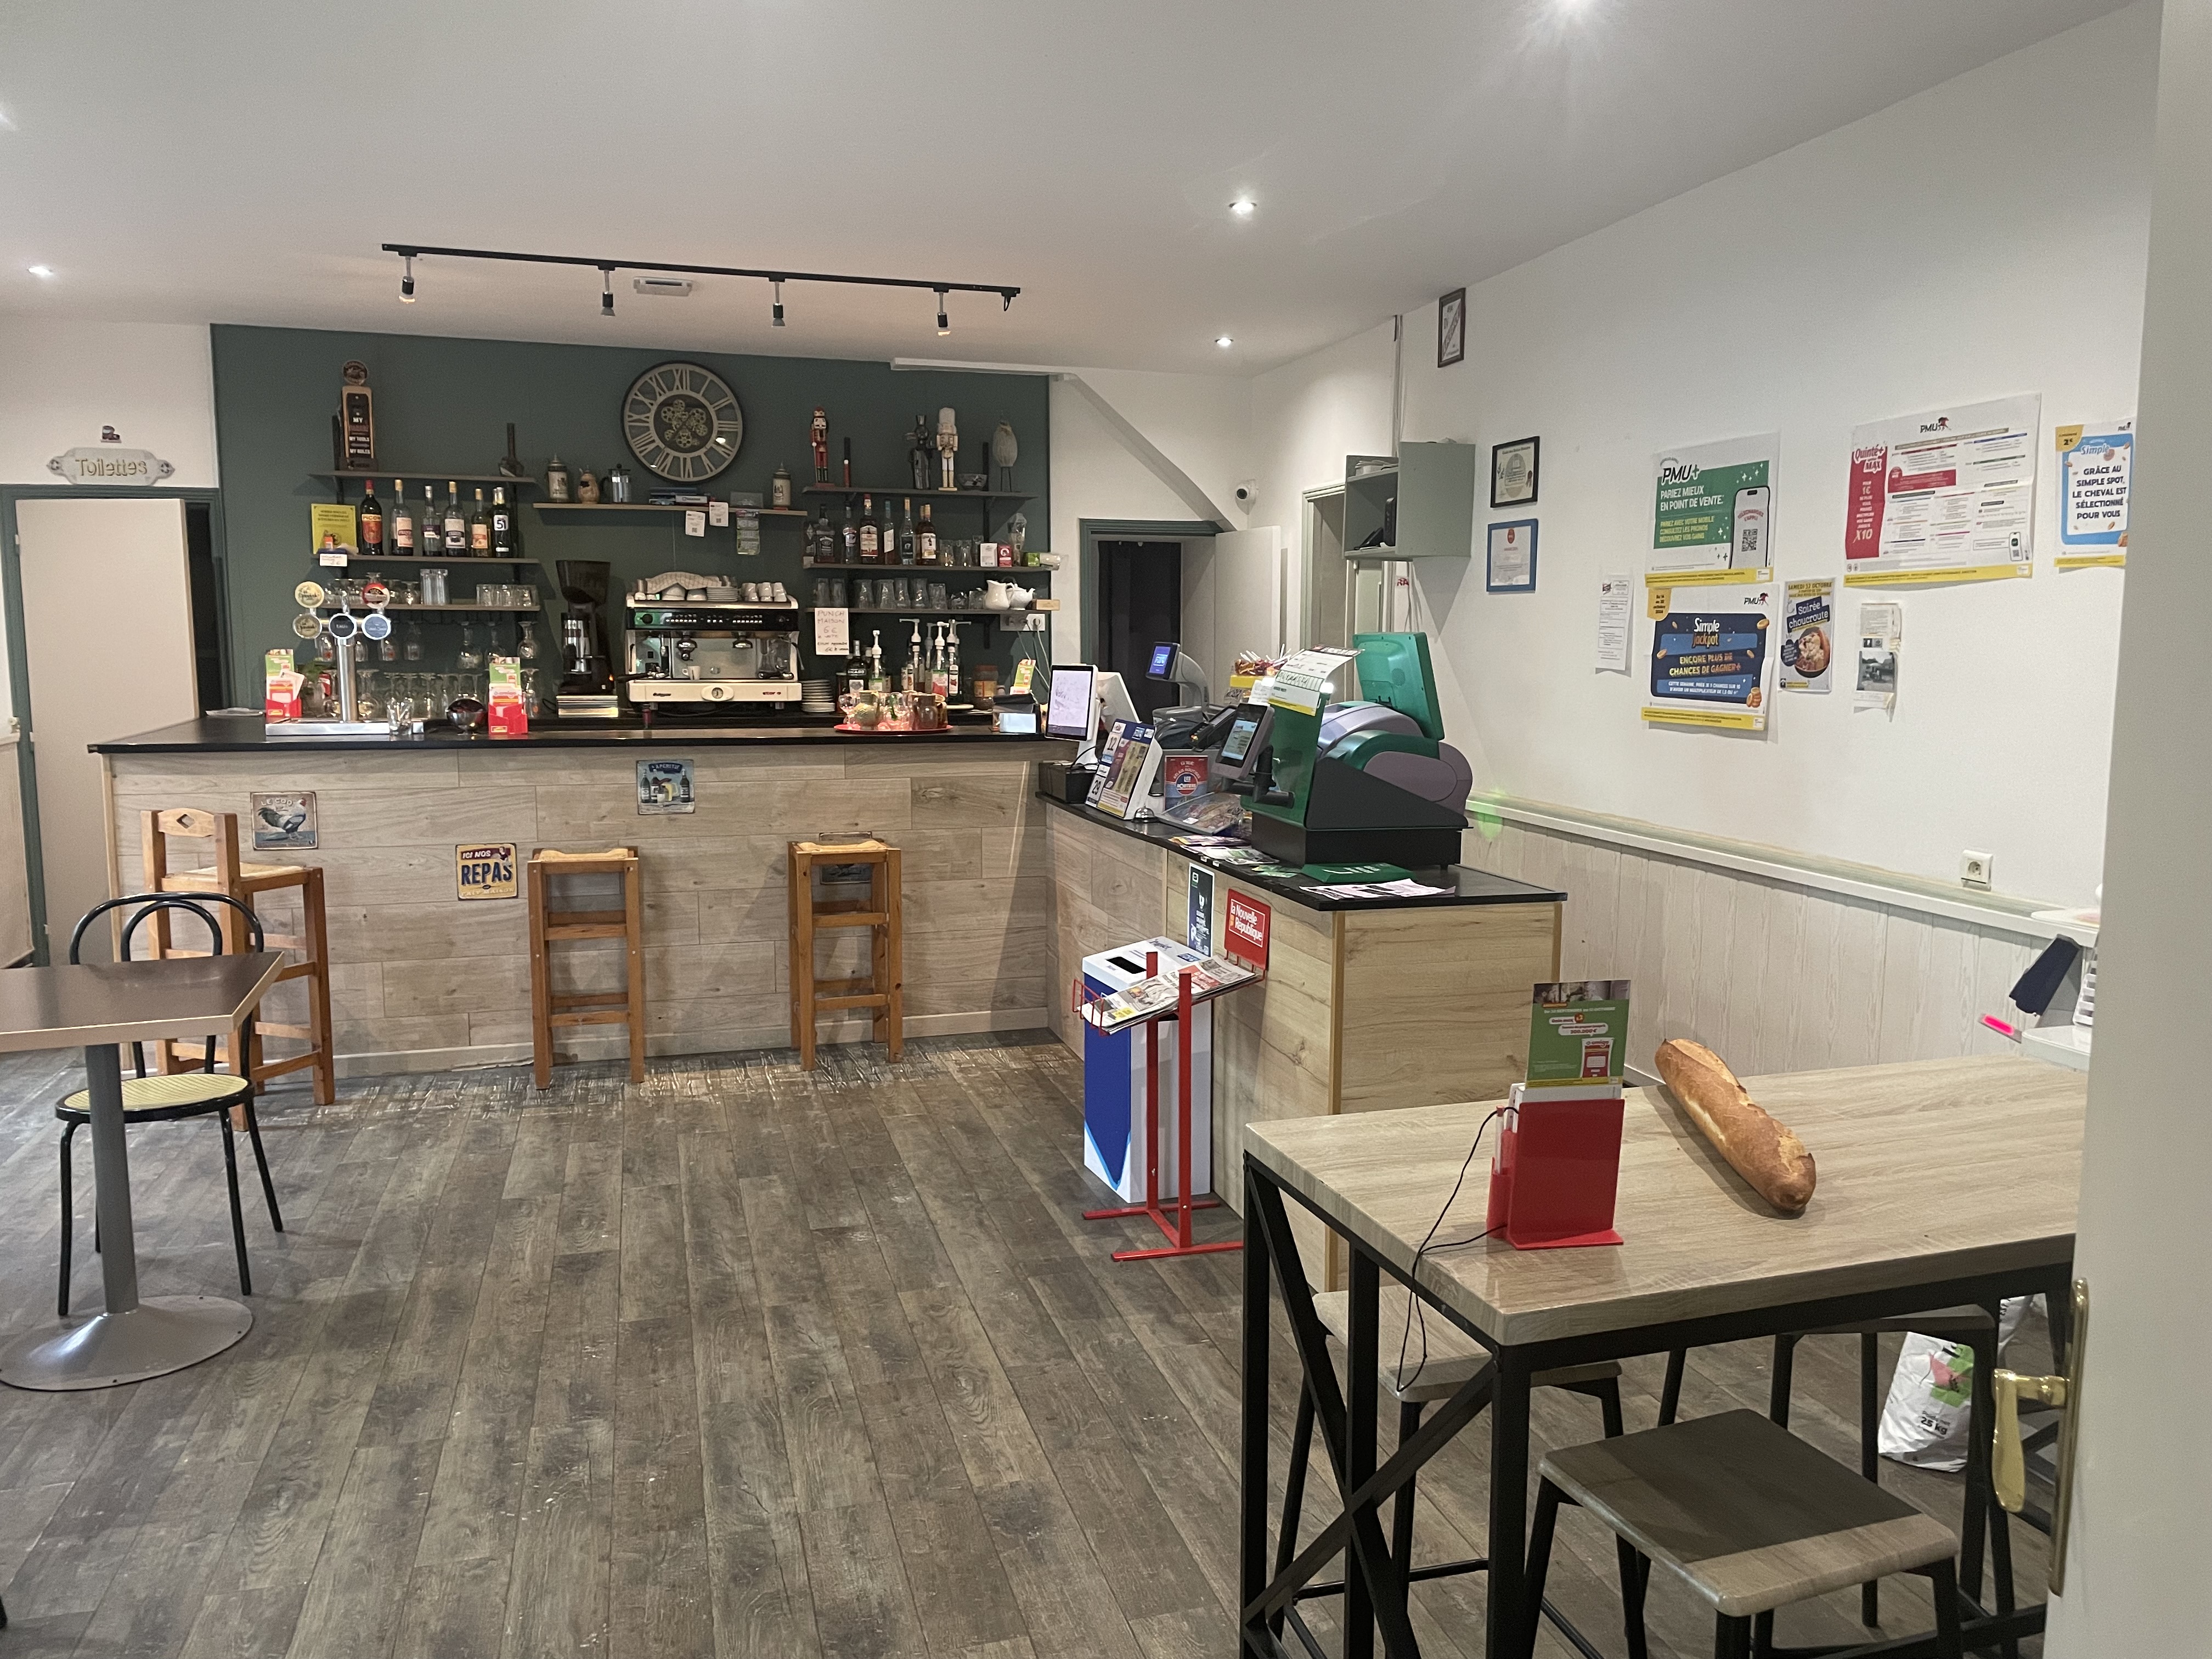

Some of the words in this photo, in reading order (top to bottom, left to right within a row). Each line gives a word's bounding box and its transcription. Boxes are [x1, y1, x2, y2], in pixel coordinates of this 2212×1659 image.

[1920, 423, 1938, 433] PMU
[1854, 443, 1884, 461] Quinté+
[2080, 442, 2111, 456] Simple
[75, 458, 148, 477] Toilettes
[1865, 460, 1881, 471] MAX
[2083, 466, 2111, 475] GRÂCE
[2076, 478, 2105, 487] SIMPLE
[1660, 488, 1681, 500] PARIEZ
[1682, 486, 1705, 497] MIEUX
[2084, 488, 2114, 497] CHEVAL
[2115, 487, 2127, 495] EST
[1660, 501, 1669, 511] EN
[1669, 499, 1688, 510] POINT
[1689, 498, 1698, 507] DE
[2075, 496, 2124, 509] SÉLECTIONNÉ
[2076, 511, 2100, 520] POUR
[2102, 510, 2121, 518] VOUS
[496, 519, 507, 529] 51
[1852, 528, 1873, 545] X10
[1743, 597, 1760, 605] PMU
[1798, 601, 1821, 615] Soirée
[1694, 617, 1720, 633] Simple
[1788, 611, 1829, 629] choucroute
[1692, 632, 1719, 647] jackpot
[1679, 654, 1706, 665] ENCORE
[1707, 653, 1724, 663] PLUS
[1669, 666, 1700, 676] CHANCES
[1701, 665, 1709, 674] DE
[461, 861, 513, 887] REPAS
[1235, 904, 1258, 926] Nouvelle
[1234, 918, 1263, 942] République
[1921, 1416, 1934, 1427] 25
[1934, 1423, 1948, 1435] kg
